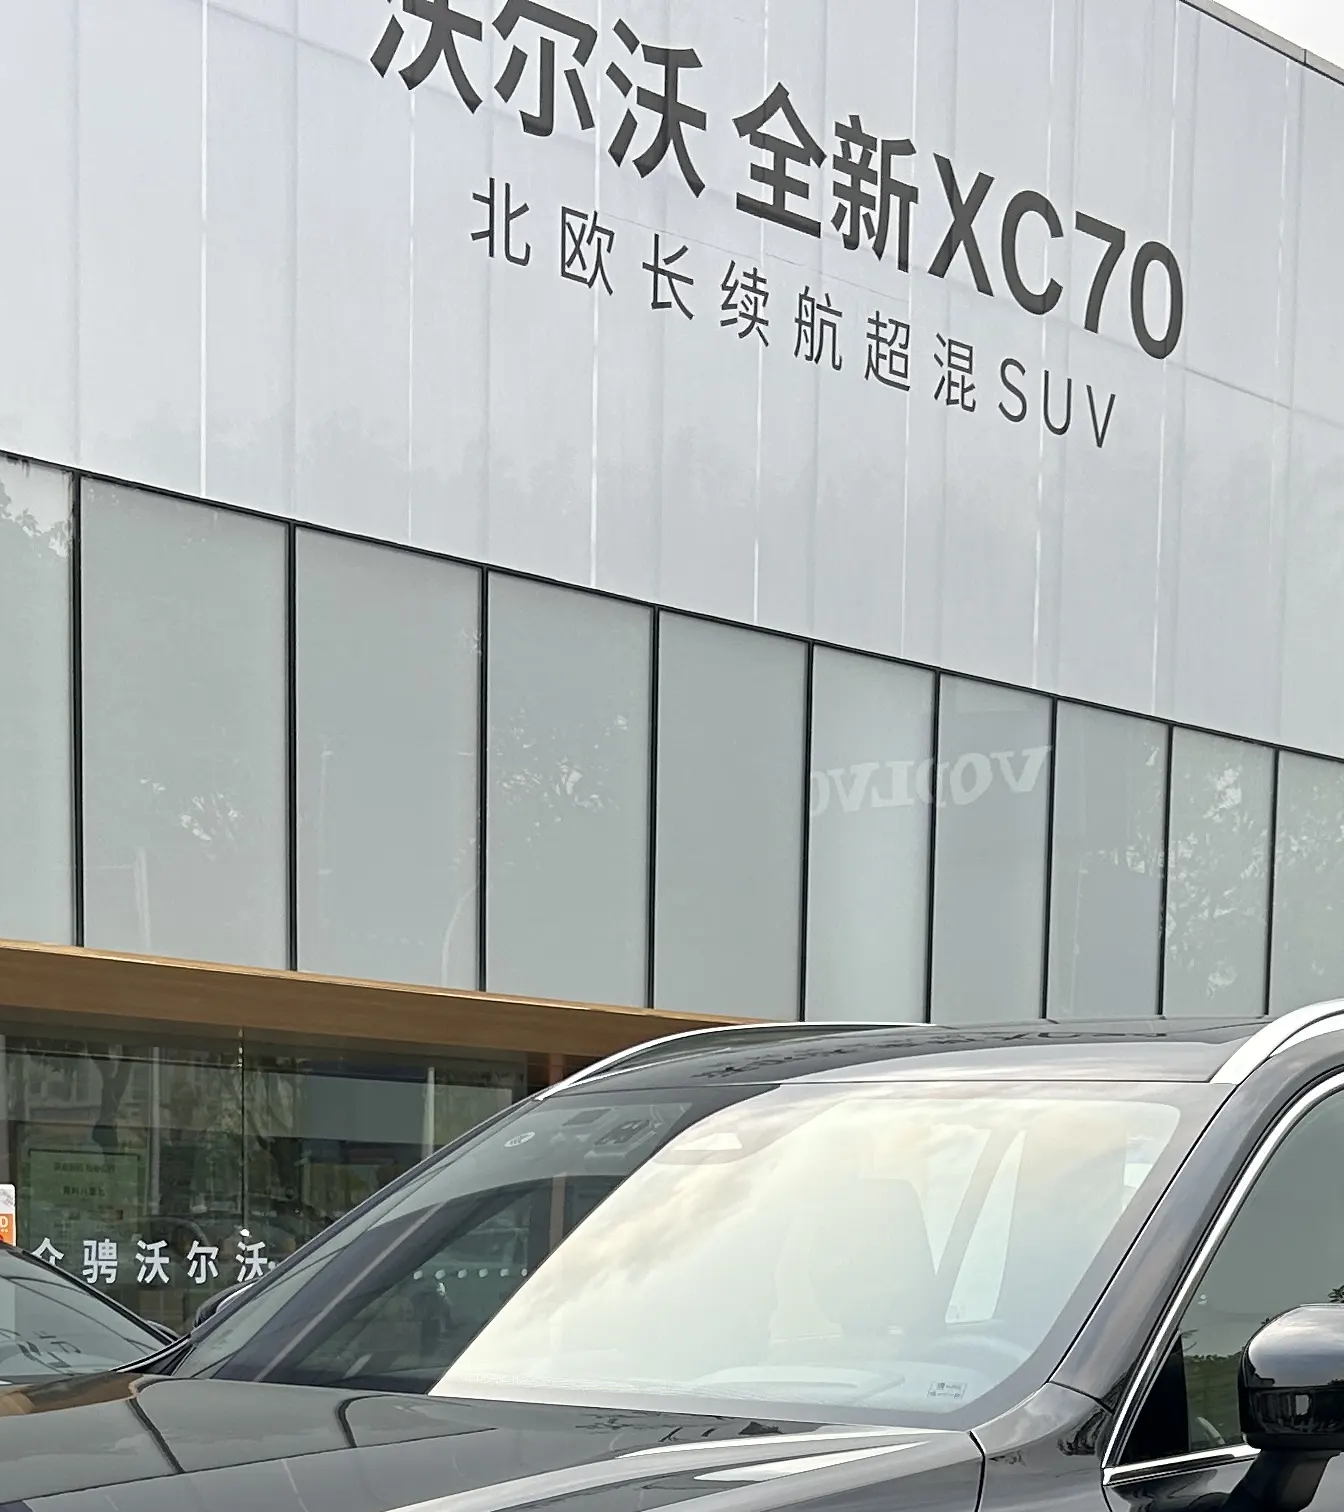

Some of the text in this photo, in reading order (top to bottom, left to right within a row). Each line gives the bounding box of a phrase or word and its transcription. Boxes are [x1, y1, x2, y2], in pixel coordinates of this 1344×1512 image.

[369, 0, 1186, 361] 沃尔沃 全新XC70
[470, 177, 1117, 449] 北欧长续航超混SUV
